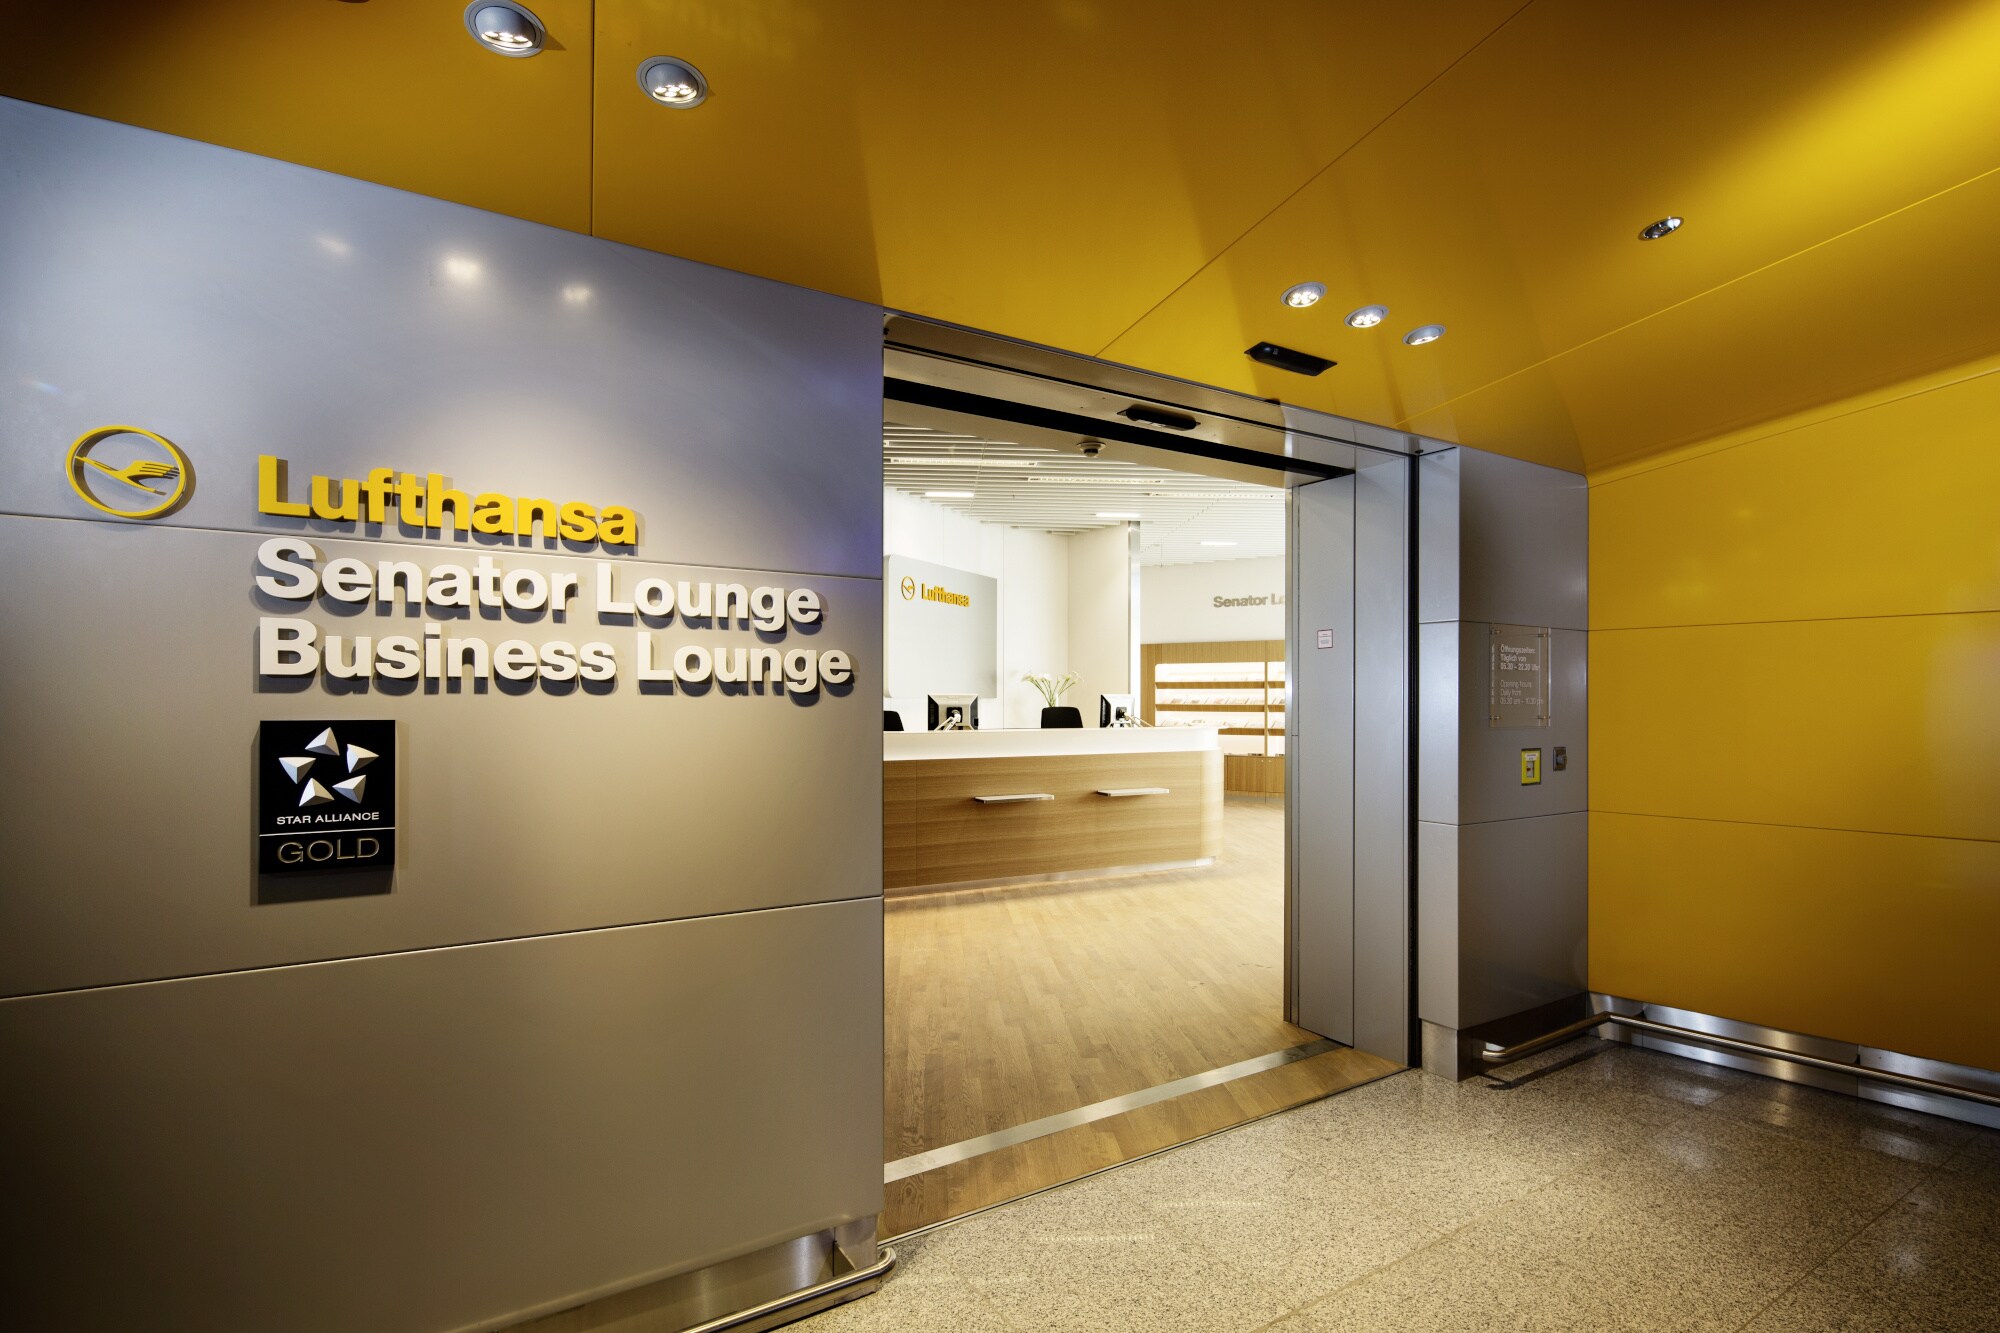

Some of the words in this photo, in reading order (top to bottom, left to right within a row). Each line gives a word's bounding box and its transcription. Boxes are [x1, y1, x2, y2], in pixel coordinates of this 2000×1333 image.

[257, 455, 638, 546] Lufthansa
[255, 537, 579, 611] Senator
[596, 563, 822, 633] Lounge
[921, 583, 970, 607] Lufthansa
[1213, 595, 1268, 608] Senator
[259, 617, 617, 681] Business
[637, 632, 854, 694] Lounge
[1500, 653, 1517, 663] Täglich
[276, 815, 312, 825] STAR
[315, 812, 380, 823] ALLIANCE
[277, 838, 380, 864] GOLD
